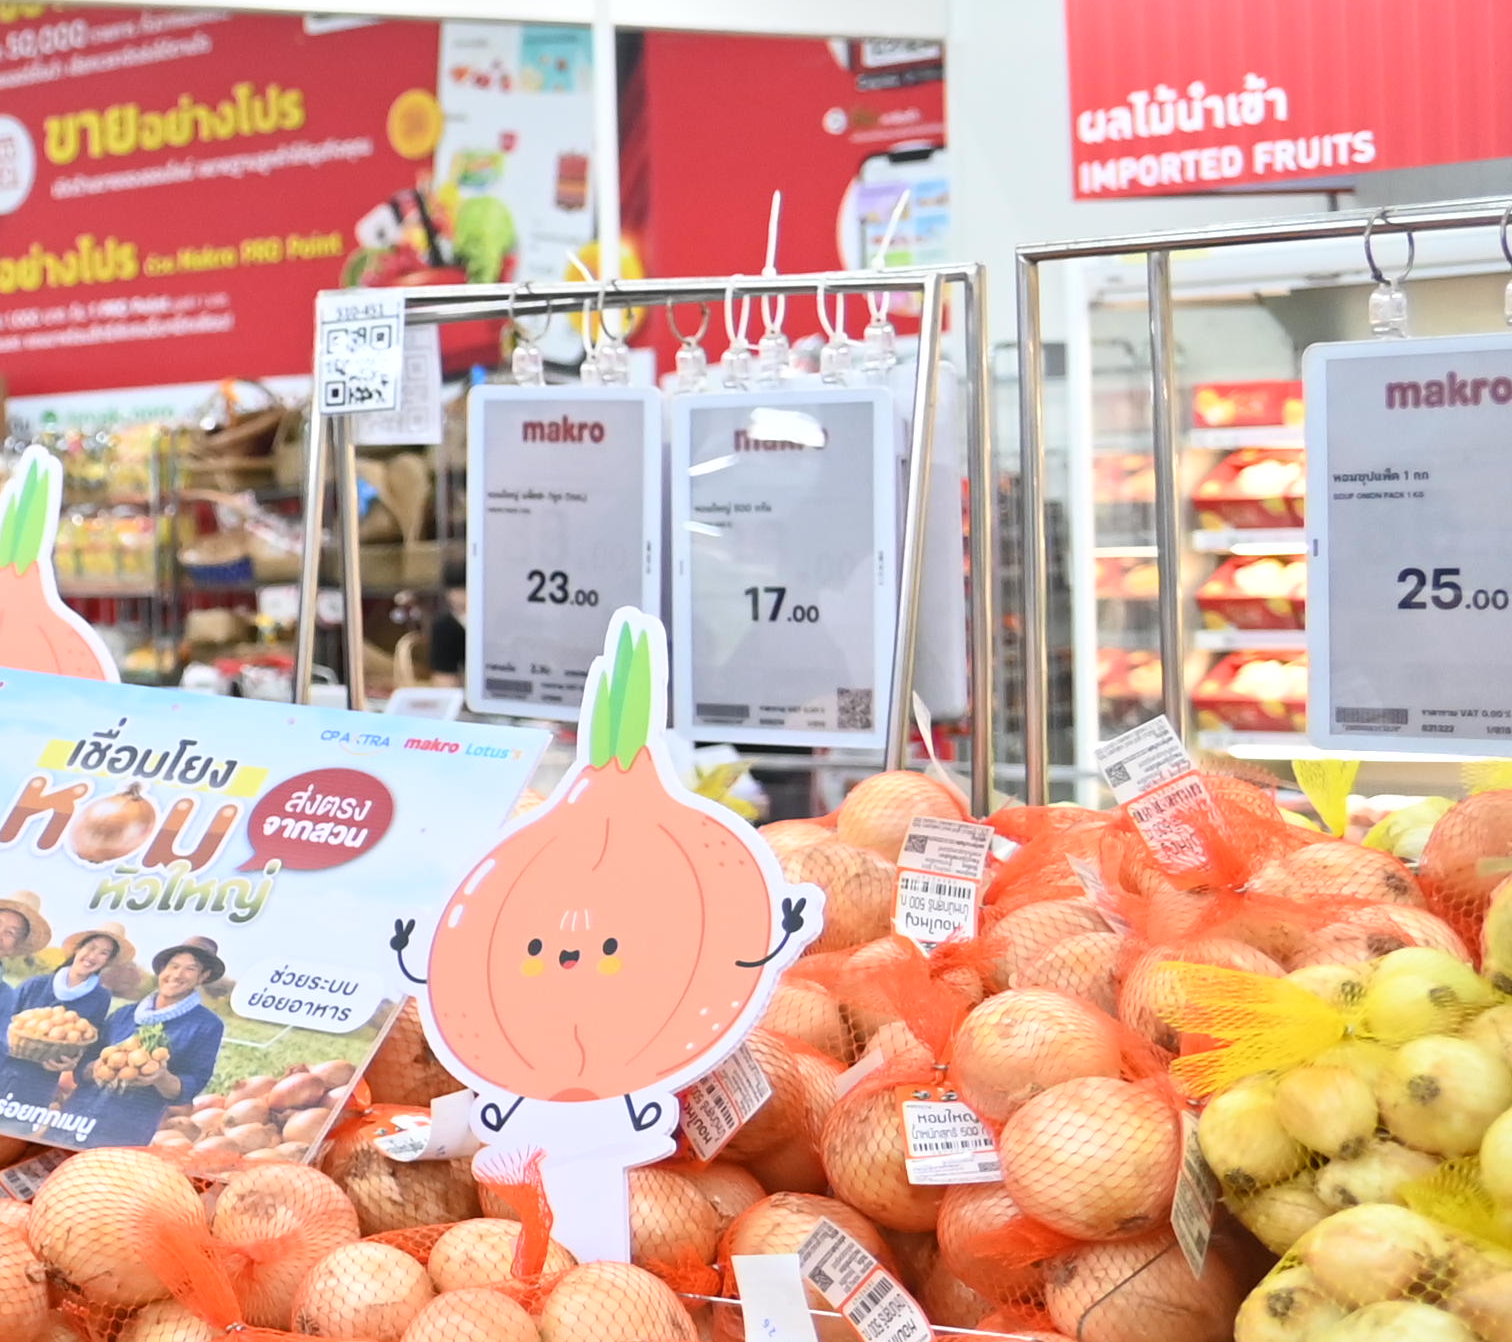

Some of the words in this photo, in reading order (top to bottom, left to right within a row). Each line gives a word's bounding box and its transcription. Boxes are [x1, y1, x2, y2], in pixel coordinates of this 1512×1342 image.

[45, 81, 305, 165] ขายอย่างโปร
[1076, 72, 1288, 145] ผลไม้นำเข้า
[1079, 145, 1244, 193] IMPORTED
[1253, 130, 1377, 175] FRUITS
[1386, 370, 1512, 410] makro
[522, 415, 605, 444] makro
[526, 569, 600, 608] 23.00
[744, 586, 820, 624] 17.00
[1396, 566, 1509, 612] 25.00
[67, 717, 237, 789] เชื่อมโยง
[403, 737, 461, 755] makro
[284, 784, 373, 822] ส่งตรง
[262, 814, 368, 850] จากสวน
[89, 859, 283, 923] หัวใหญ่
[268, 963, 359, 999] ช่วยระบบ
[246, 987, 353, 1024] ย่อยอาหาร
[961, 1126, 978, 1139] 500
